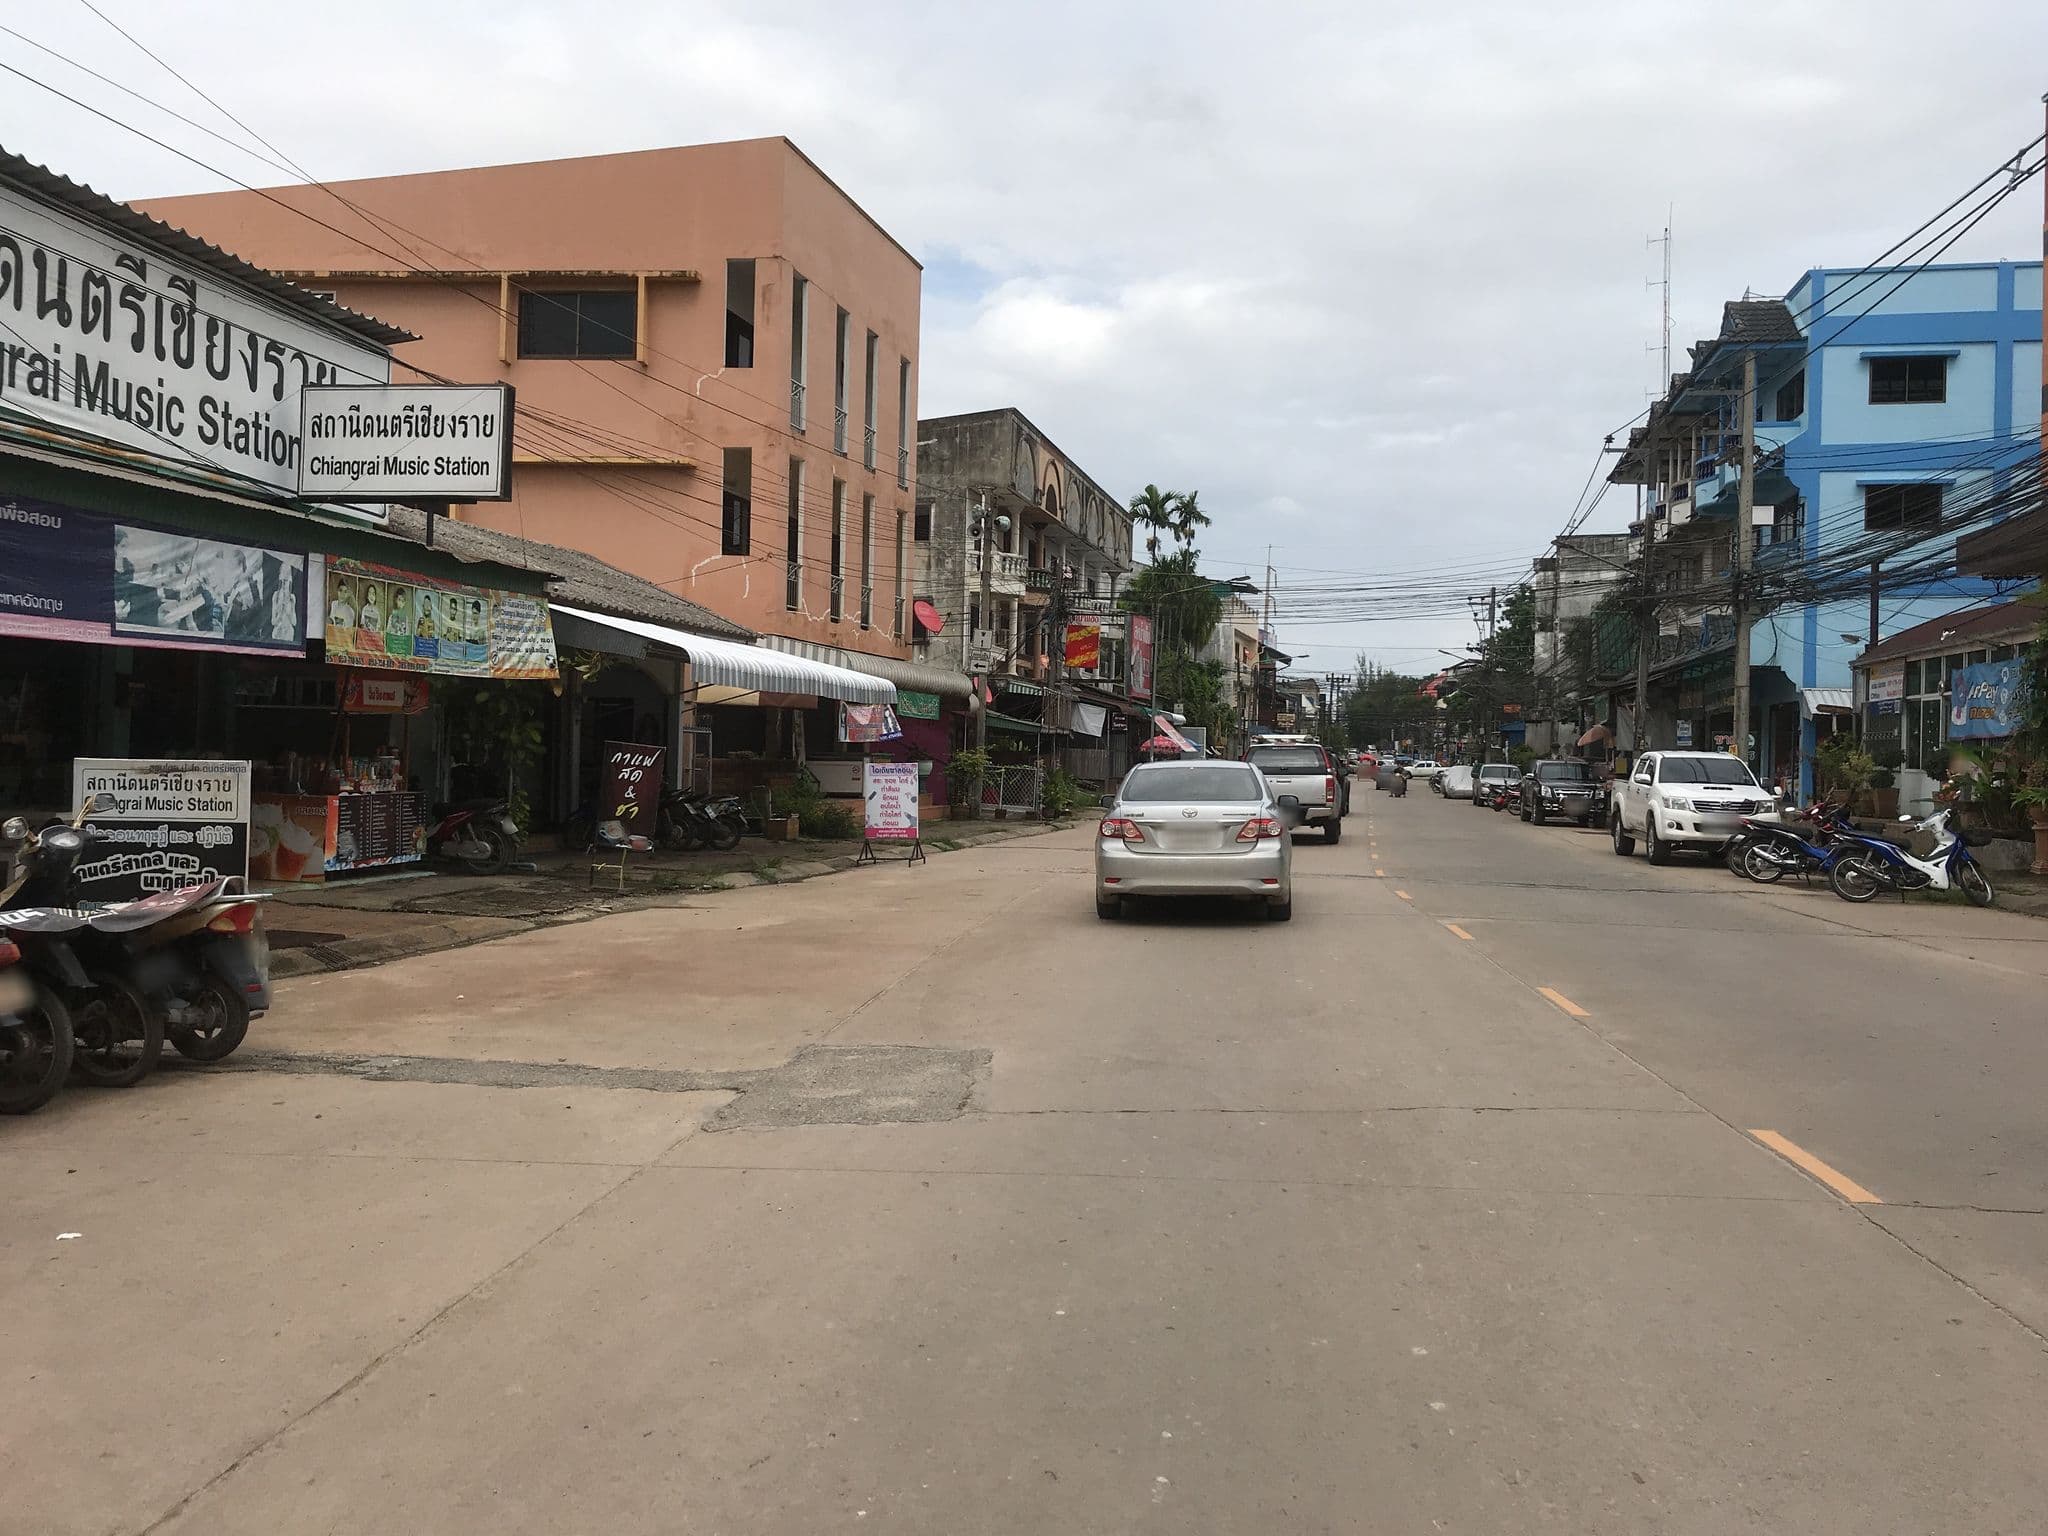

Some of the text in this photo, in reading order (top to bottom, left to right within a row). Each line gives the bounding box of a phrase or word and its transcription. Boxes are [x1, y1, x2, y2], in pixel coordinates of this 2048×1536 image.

[74, 352, 185, 437] Music
[197, 394, 301, 470] Station
[310, 404, 495, 439] สถานีดนตรีเชียงราย
[310, 456, 490, 481] Chiangrai Music Station
[610, 749, 662, 767] กาแฟ
[86, 773, 231, 792] สถานีดนตรีเชียงราย
[618, 766, 643, 783] สด
[624, 785, 637, 799] &
[145, 797, 183, 811] Music
[187, 798, 233, 812] Station
[615, 801, 639, 819] ชา
[170, 829, 194, 843] และ
[167, 853, 200, 871] และ
